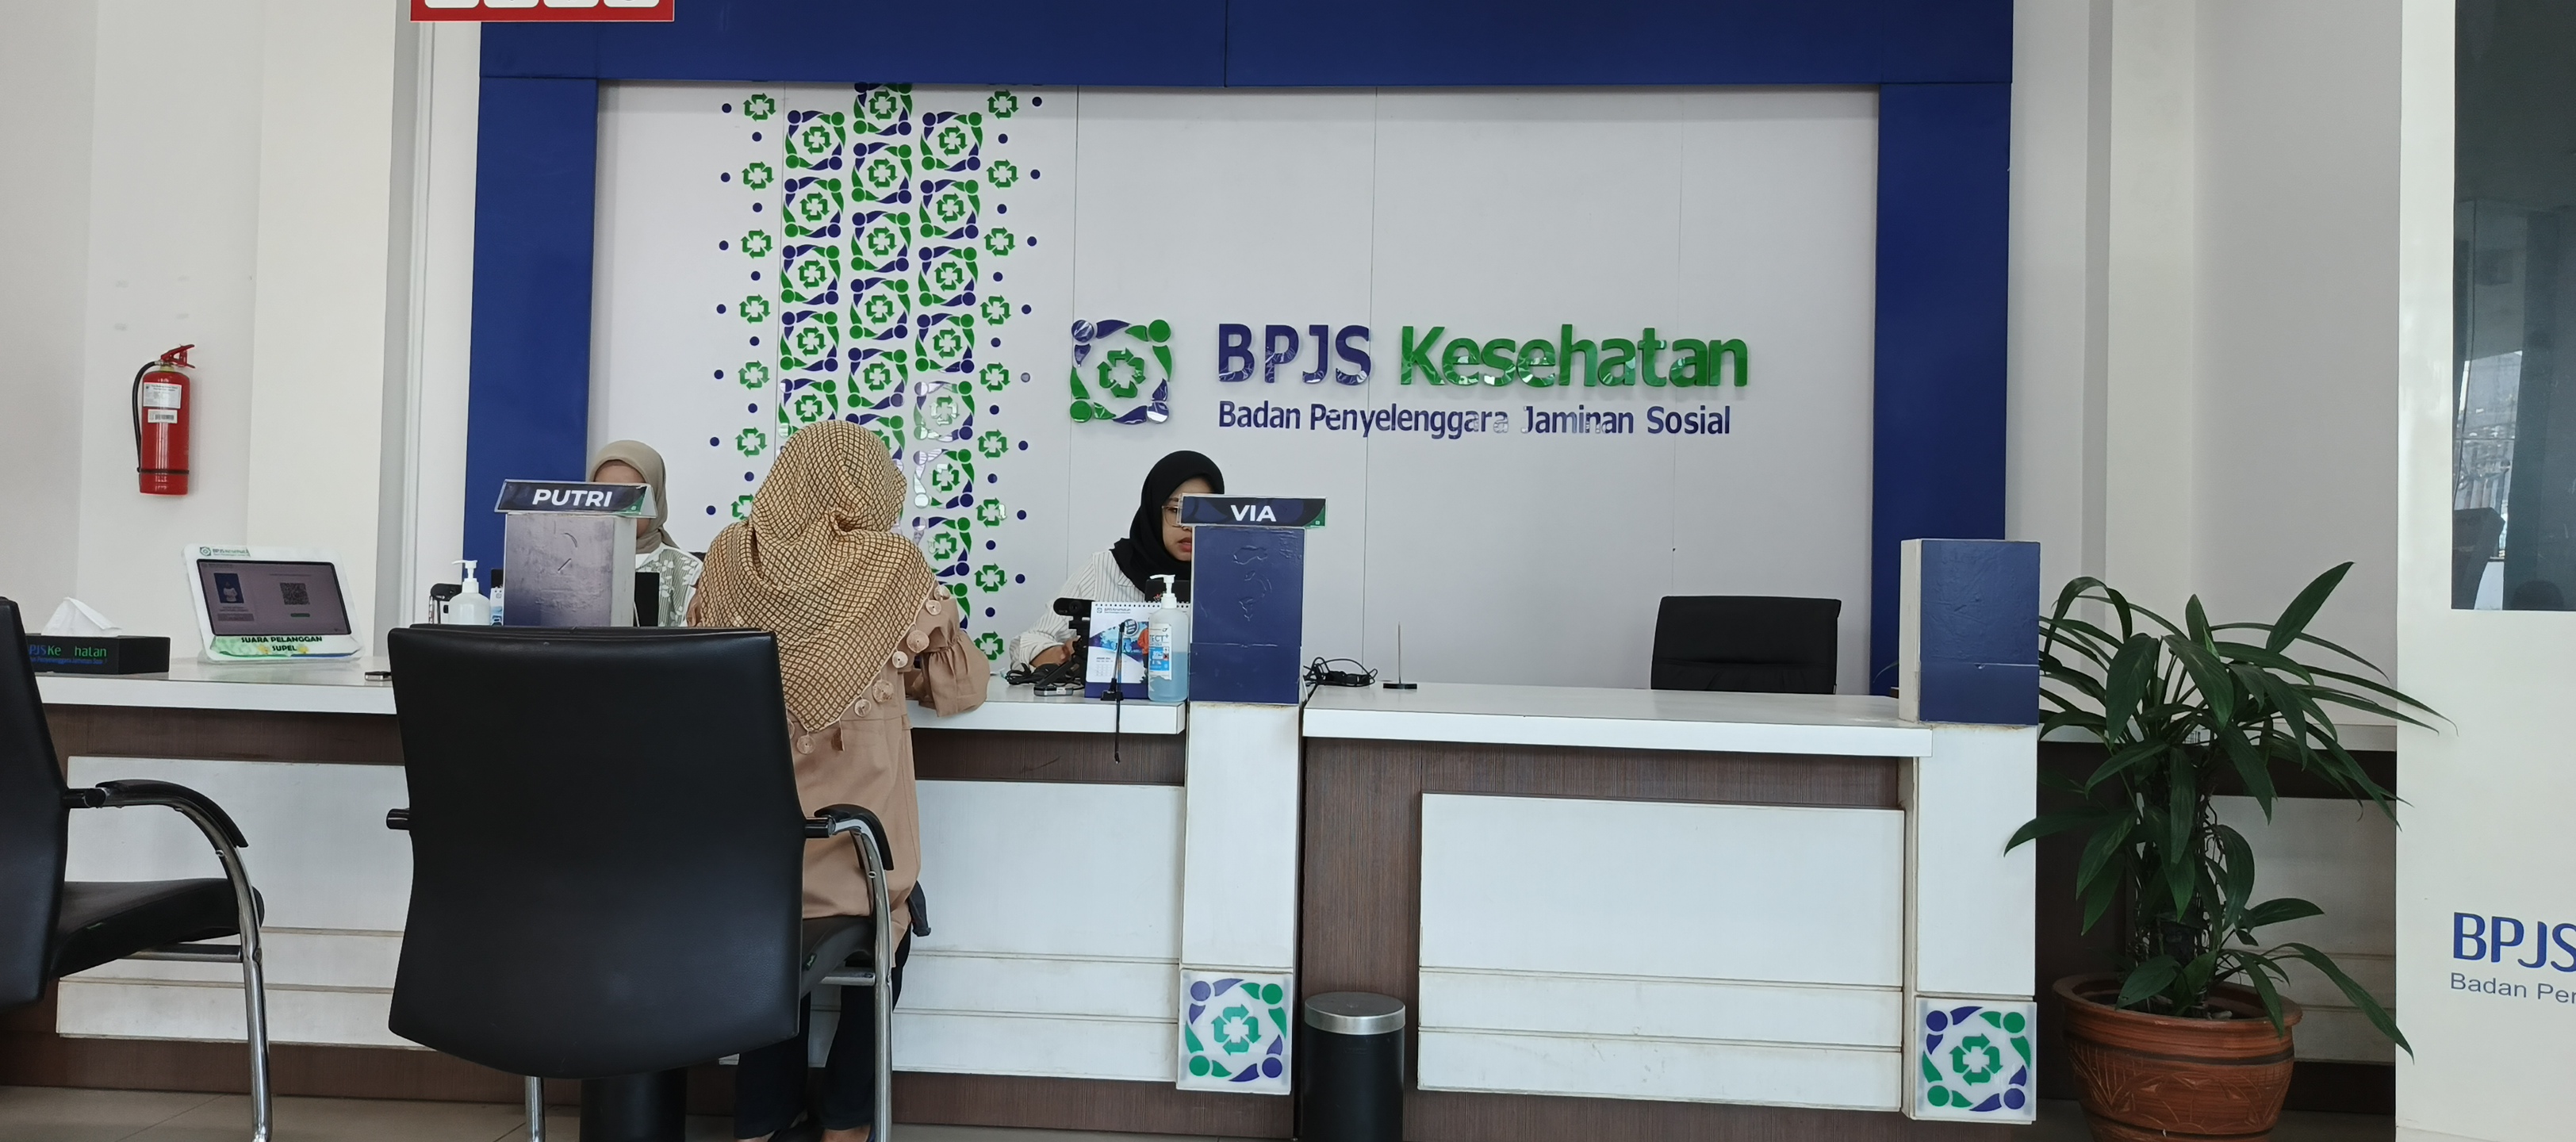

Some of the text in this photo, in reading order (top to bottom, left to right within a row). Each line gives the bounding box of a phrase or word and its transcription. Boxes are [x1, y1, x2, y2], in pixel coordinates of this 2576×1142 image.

[1218, 324, 1748, 387] BPJS Kesehatan
[1219, 400, 1731, 439] Badan Penyelenggara Jaminan Sosial
[532, 489, 613, 508] PUTRI
[1230, 504, 1277, 522] VIA
[2453, 912, 2576, 972] BPJS
[2451, 972, 2528, 998] Badan
